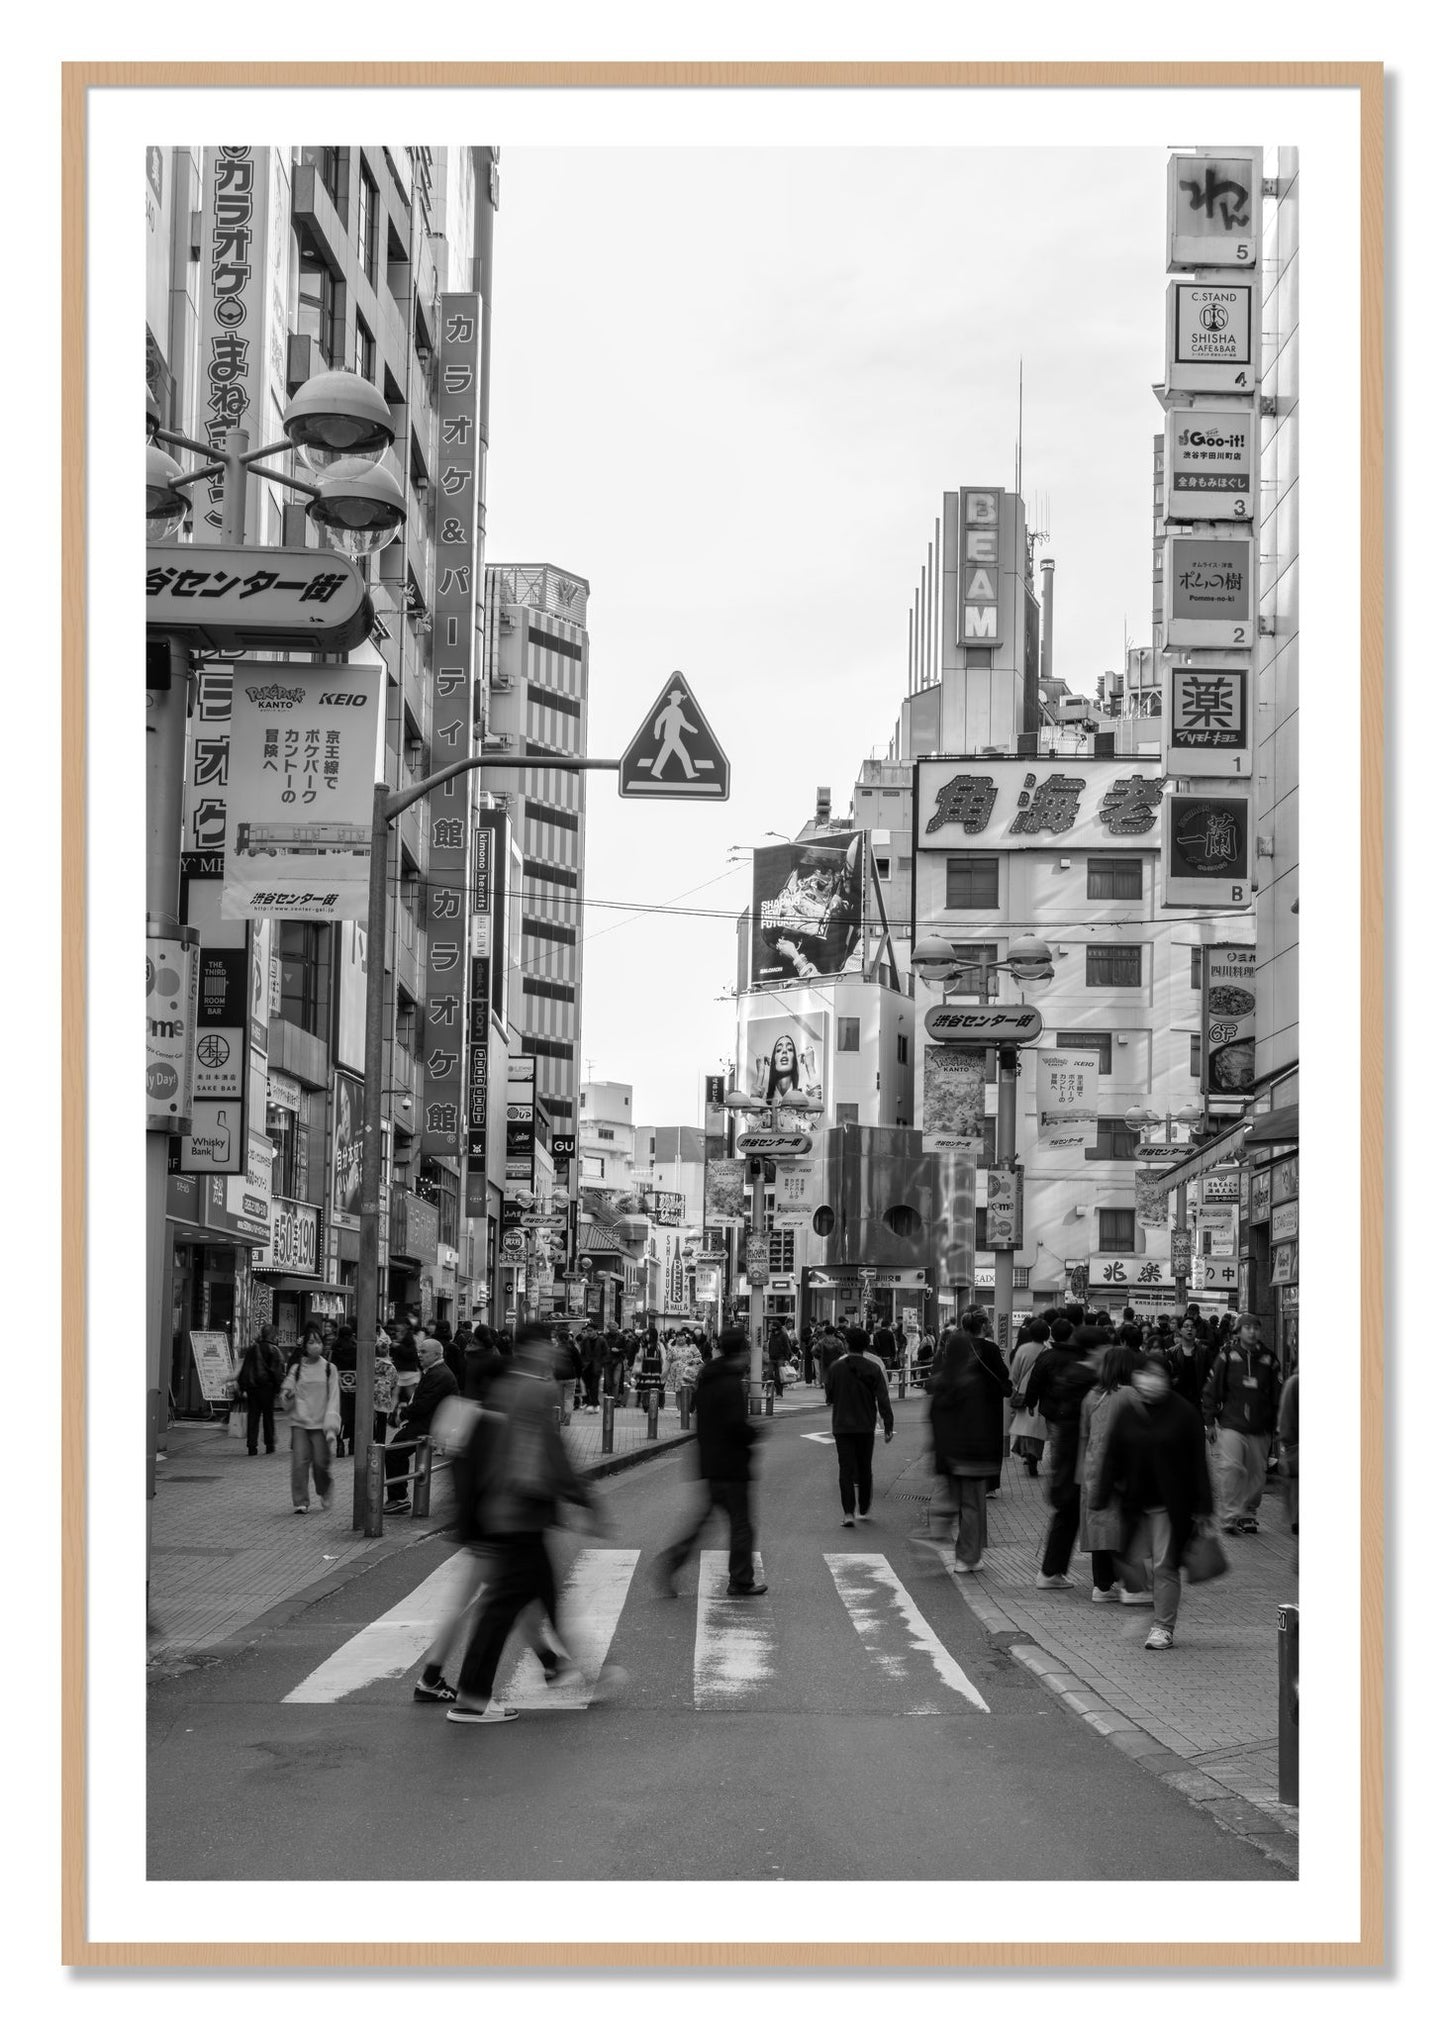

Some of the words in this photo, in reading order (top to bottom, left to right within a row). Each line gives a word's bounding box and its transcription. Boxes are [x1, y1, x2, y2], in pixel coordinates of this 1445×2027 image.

[213, 158, 254, 298] カラオケ
[1236, 244, 1248, 260] 5
[1191, 292, 1237, 302] C.STAND
[1191, 333, 1236, 344] SHISHA
[1191, 344, 1236, 353] CAFE&BAR
[1234, 371, 1248, 388] 4
[1189, 431, 1245, 448] Goo-it!
[1178, 476, 1247, 489] 全身もみほぐし
[1233, 499, 1246, 516] 3
[964, 493, 998, 638] BEAM
[1233, 627, 1246, 644] 2
[258, 701, 293, 709] KANTO
[318, 693, 368, 707] KEIO
[1182, 676, 1233, 727] 薬
[262, 728, 279, 772] 冒険へ
[281, 728, 299, 804] カントーの
[323, 730, 341, 790] 京王線で
[1233, 757, 1241, 773] 1
[478, 833, 488, 869] kimono
[250, 892, 339, 906] 渋谷センター街
[477, 874, 487, 909] hearts
[1232, 886, 1243, 901] B
[204, 968, 227, 976] THIRD
[932, 1014, 1036, 1029] 渋谷センター街
[1208, 1022, 1239, 1044] 6F
[156, 1073, 177, 1088] Day!
[191, 1146, 212, 1156] Bank
[192, 1137, 225, 1149] Whisky
[553, 1140, 575, 1152] GU
[672, 1260, 682, 1302] BEER
